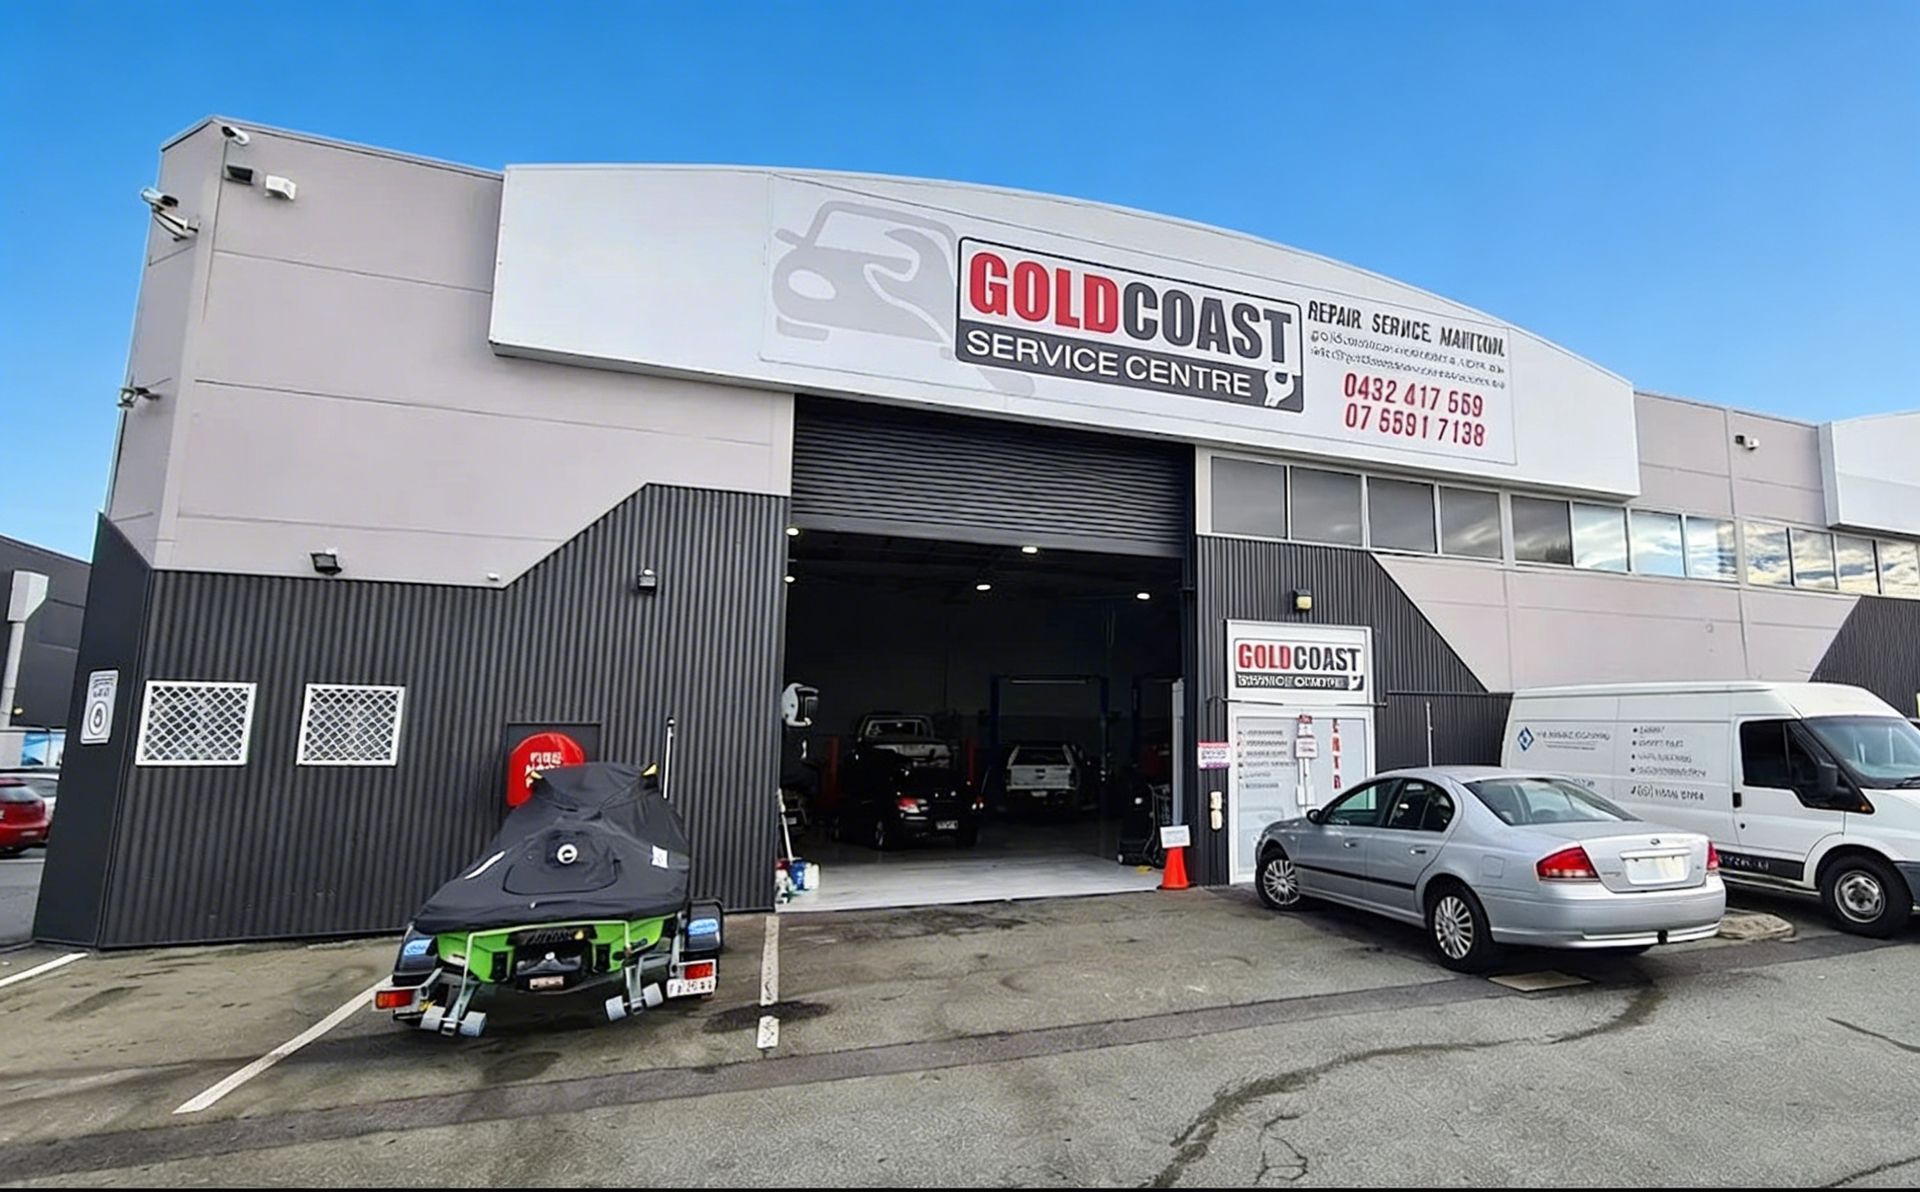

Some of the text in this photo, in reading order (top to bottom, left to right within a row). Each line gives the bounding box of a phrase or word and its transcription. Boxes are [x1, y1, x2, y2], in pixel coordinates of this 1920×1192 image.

[969, 252, 1292, 364] GOLDCOAST
[1308, 300, 1362, 330] REPAIR
[966, 330, 1252, 397] SERVICE CENTRE
[1344, 373, 1397, 404] 0432
[1404, 382, 1441, 411] 417
[1345, 403, 1371, 430] 07
[1438, 418, 1485, 447] 7138
[1238, 644, 1361, 671] GOLDCOAST
